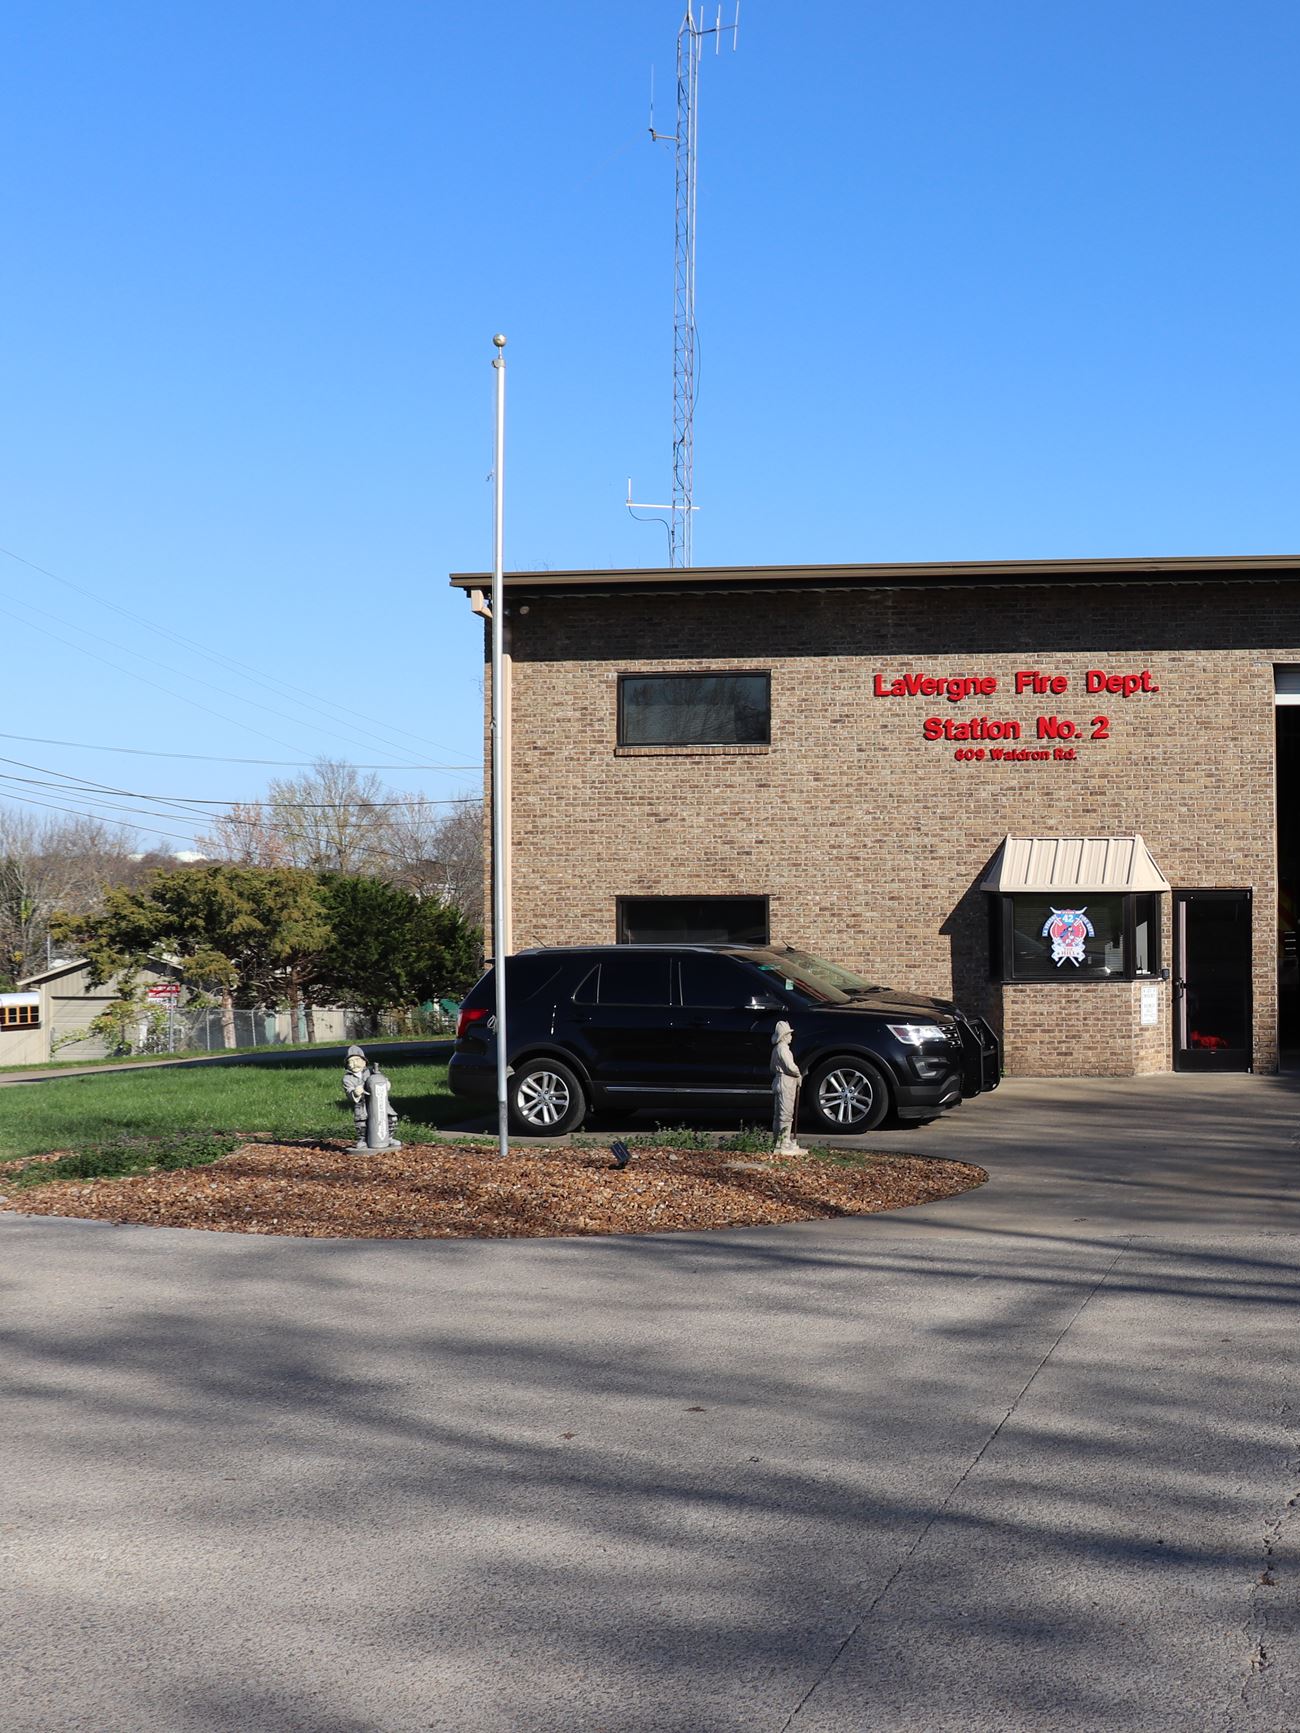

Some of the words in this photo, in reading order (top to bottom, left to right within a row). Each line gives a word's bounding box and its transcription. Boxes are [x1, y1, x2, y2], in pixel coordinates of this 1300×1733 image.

[874, 673, 997, 701] LaVergne
[1015, 670, 1068, 694] Fire
[1086, 669, 1160, 698] Dept.
[923, 716, 1021, 741] Station
[1036, 716, 1083, 740] No.
[1090, 715, 1110, 740] 2
[954, 748, 986, 761] 609
[989, 748, 1051, 761] Waldron
[1053, 748, 1078, 761] Rd.
[1062, 914, 1074, 923] 42
